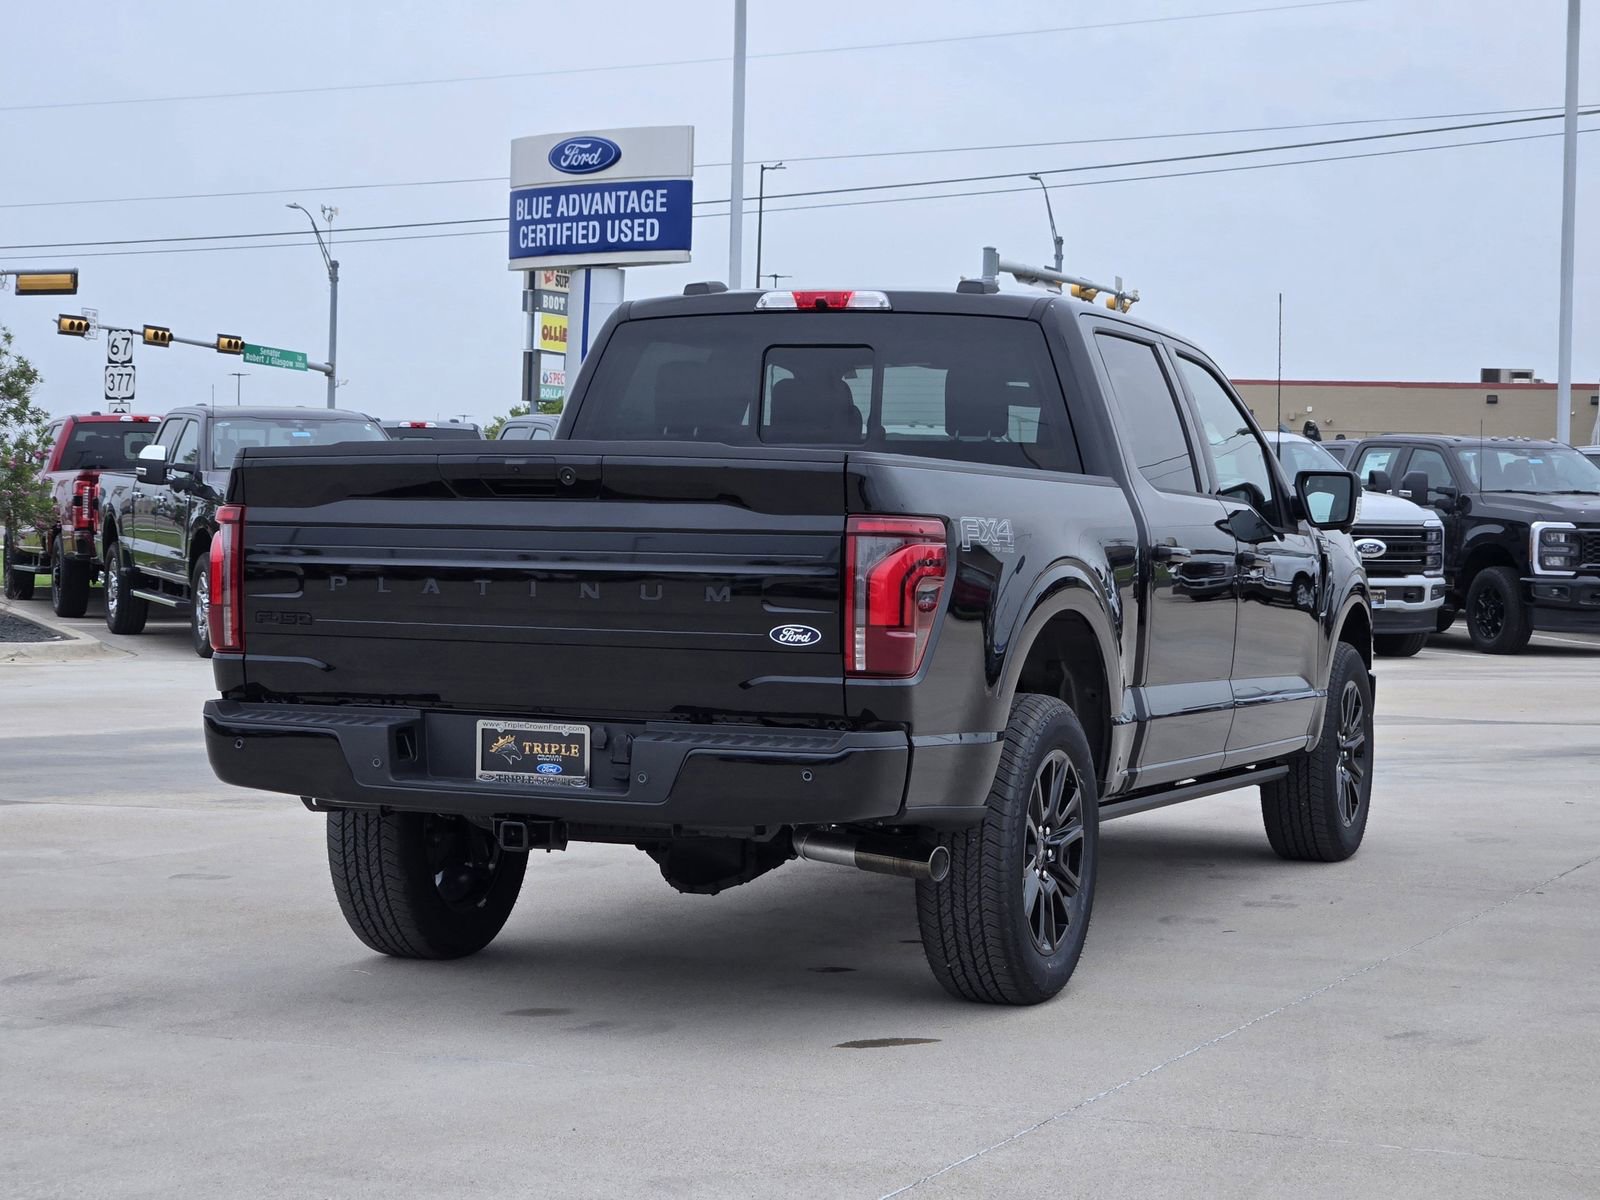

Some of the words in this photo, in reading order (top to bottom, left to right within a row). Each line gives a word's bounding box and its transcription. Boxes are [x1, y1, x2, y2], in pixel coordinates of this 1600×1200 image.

[560, 143, 602, 166] Ford
[516, 195, 553, 221] BLUE
[556, 188, 668, 218] ADVANTAGE
[519, 220, 600, 249] CERTIFIED
[606, 218, 660, 243] USED
[555, 274, 570, 289] SUP
[542, 294, 566, 311] BOOT
[110, 337, 131, 356] 67
[260, 346, 281, 358] Senator
[245, 352, 265, 363] Robert
[271, 357, 294, 368] Glasgow
[107, 373, 133, 392] 377
[541, 388, 564, 398] DOLLA
[960, 516, 1015, 552] FX4
[1361, 543, 1379, 553] Ford
[329, 575, 731, 602] PLATINUM
[778, 627, 812, 643] Ford
[522, 741, 580, 757] TRIPLE
